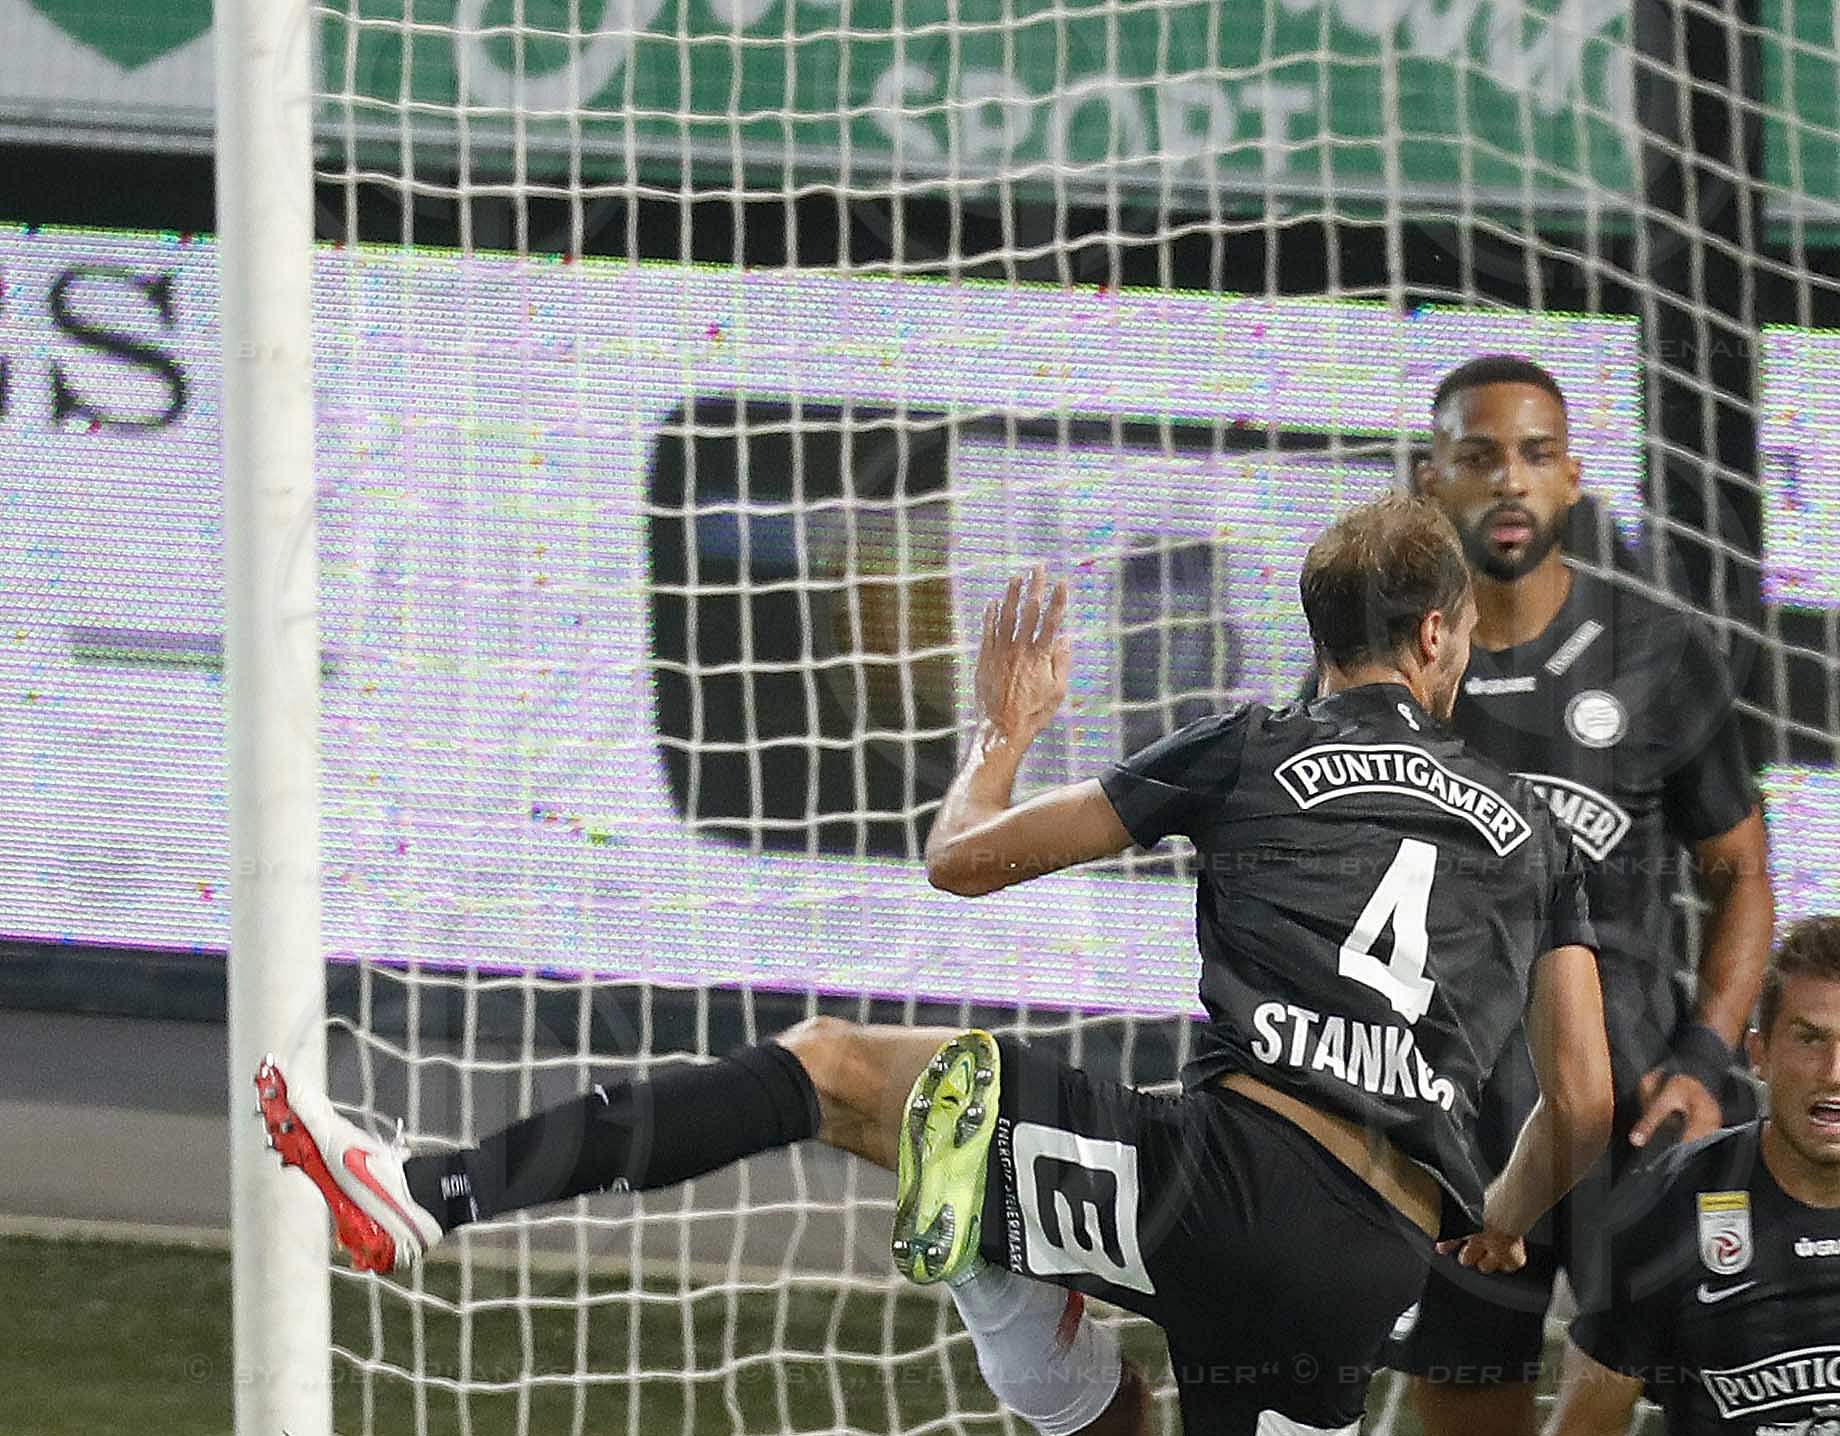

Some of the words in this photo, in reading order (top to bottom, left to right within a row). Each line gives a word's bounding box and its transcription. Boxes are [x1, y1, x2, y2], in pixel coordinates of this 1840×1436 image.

[0, 267, 188, 428] S
[1291, 752, 1518, 842] PUNTIGAMER
[1338, 838, 1438, 1025] 4
